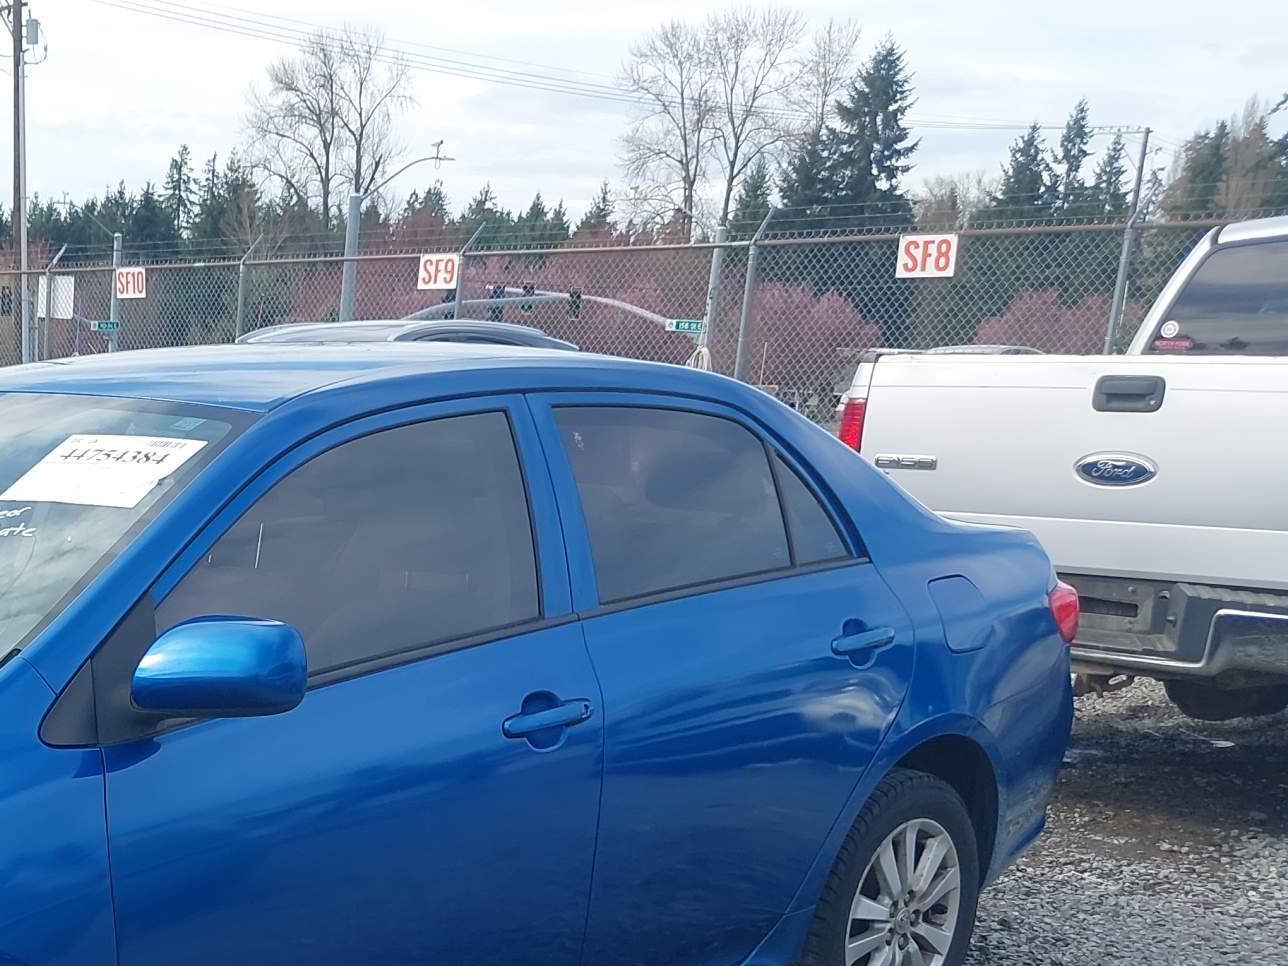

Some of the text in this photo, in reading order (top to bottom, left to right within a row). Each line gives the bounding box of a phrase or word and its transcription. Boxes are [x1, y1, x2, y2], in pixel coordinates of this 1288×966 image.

[903, 239, 951, 272] SF8
[118, 271, 144, 294] SF10
[422, 258, 455, 284] SF9
[60, 448, 170, 465] 44754384
[1092, 460, 1135, 478] Ford
